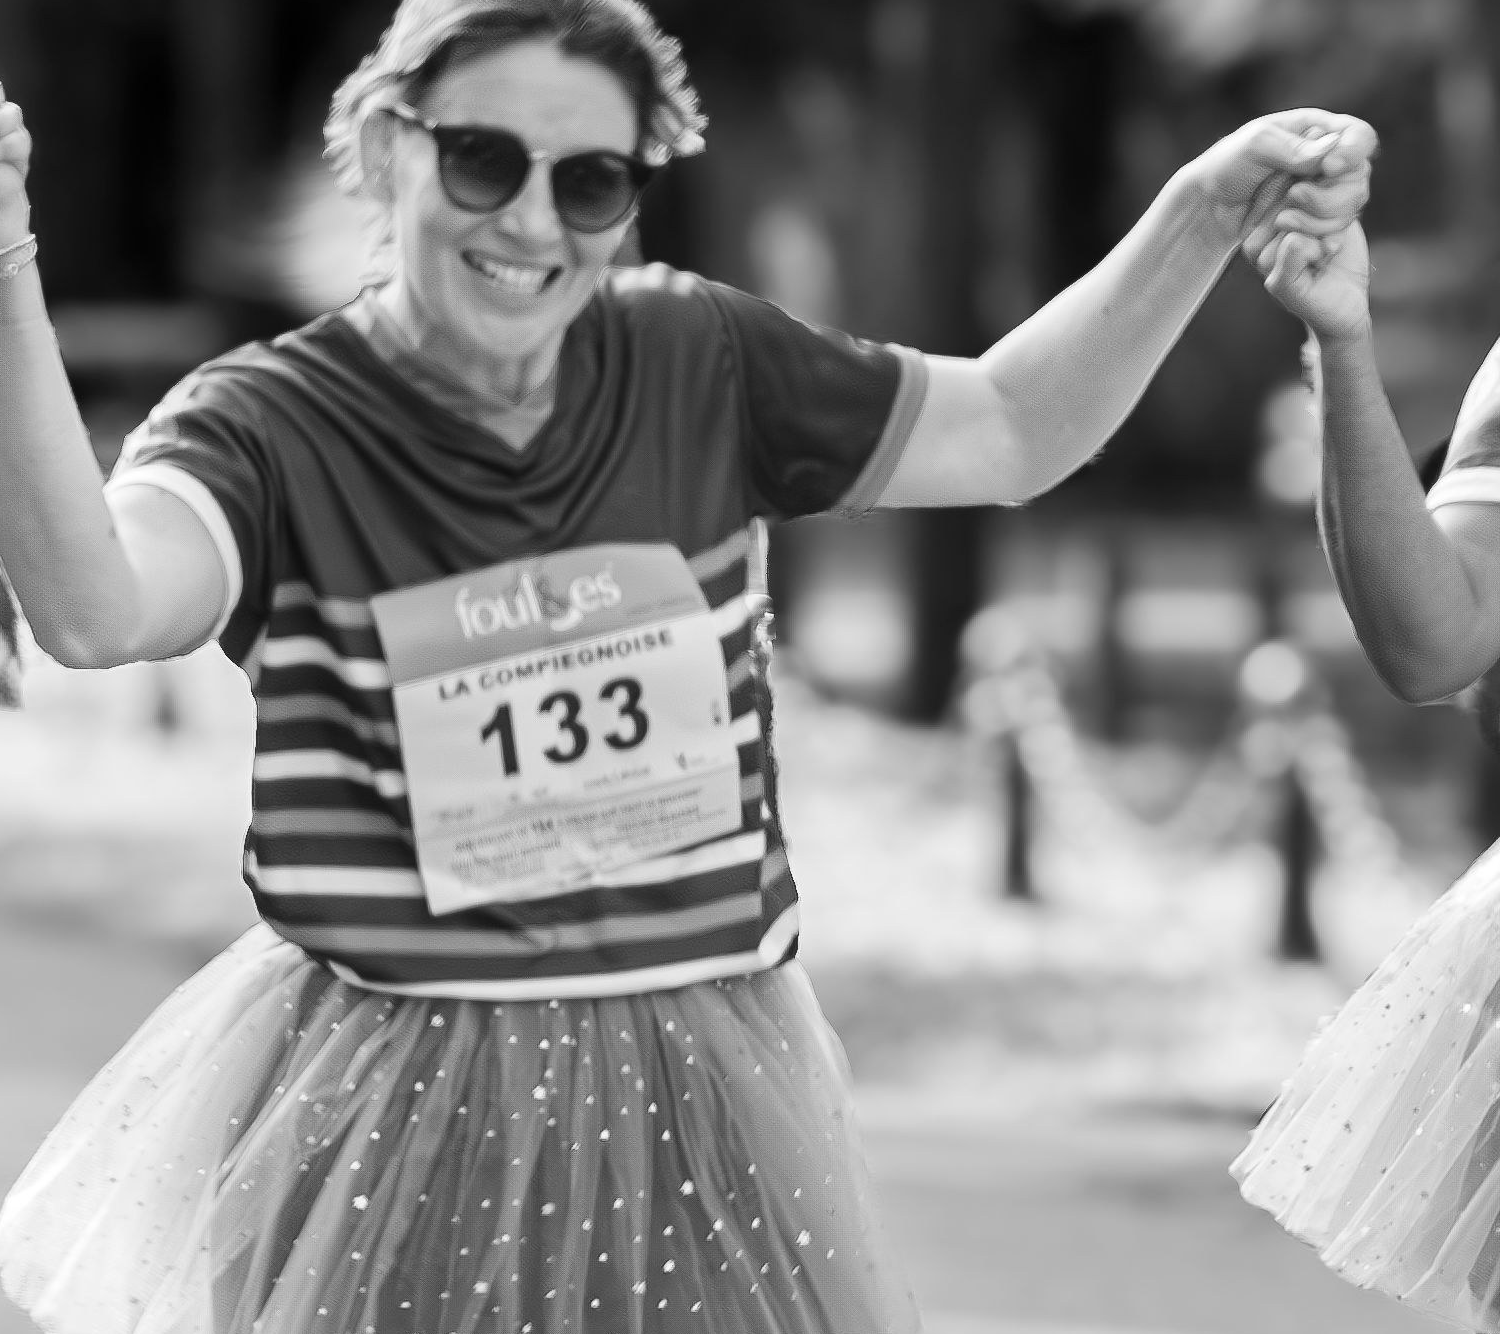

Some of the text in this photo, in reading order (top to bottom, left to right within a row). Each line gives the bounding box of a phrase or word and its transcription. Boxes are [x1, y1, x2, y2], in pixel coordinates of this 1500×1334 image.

[438, 628, 674, 702] LA COMPIEGNOISE
[479, 677, 650, 778] 133
